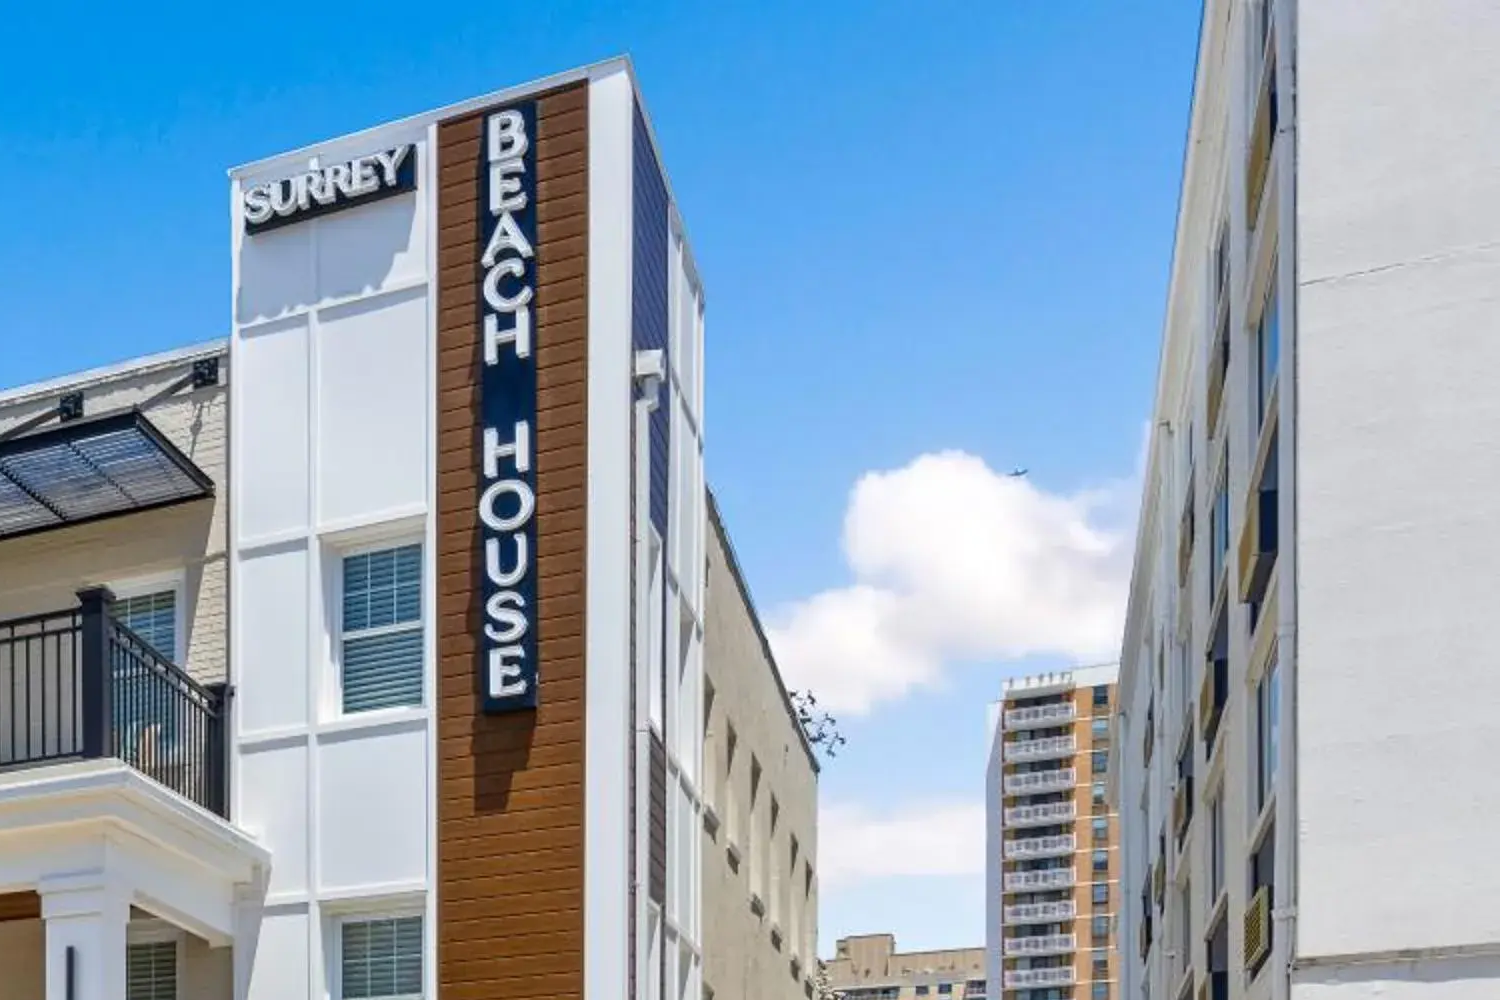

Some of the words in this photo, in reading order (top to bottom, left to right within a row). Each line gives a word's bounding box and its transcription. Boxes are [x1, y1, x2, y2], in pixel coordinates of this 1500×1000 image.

[245, 145, 407, 224] SURREY
[481, 109, 534, 366] BEACH
[479, 420, 535, 698] HOUSE
